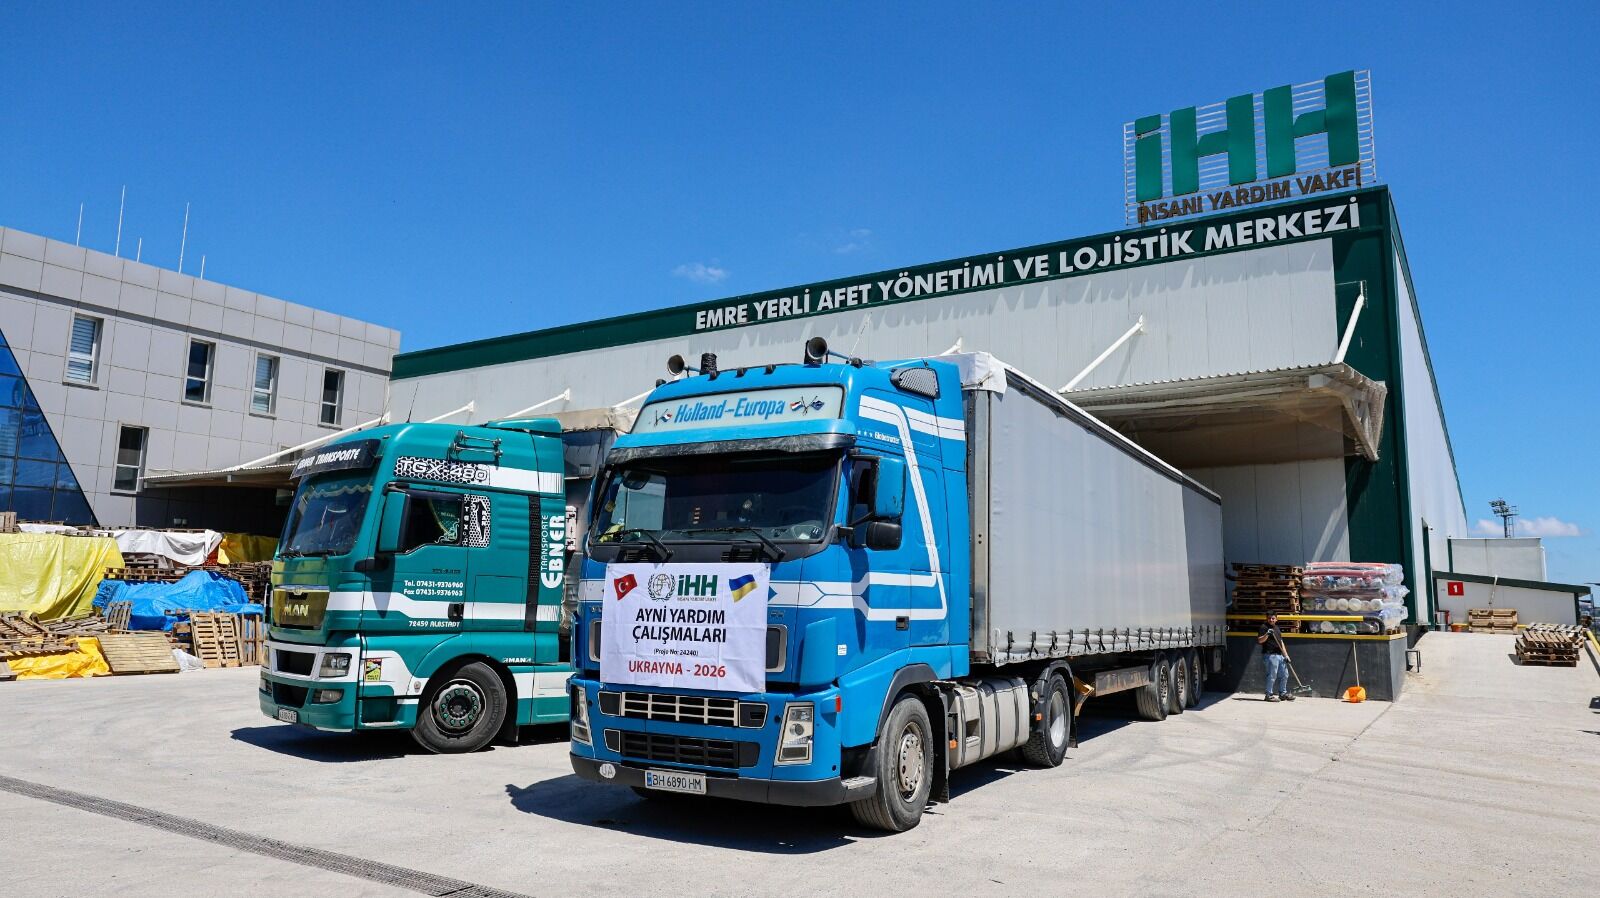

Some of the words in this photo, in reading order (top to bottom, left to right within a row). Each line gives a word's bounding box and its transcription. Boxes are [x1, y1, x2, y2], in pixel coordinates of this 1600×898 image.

[1207, 180, 1290, 210] YARDIM
[695, 303, 748, 330] EMRE
[753, 288, 810, 320] YERLİ
[817, 283, 872, 312] AFET
[877, 255, 1004, 301] YÖNETİMİ
[1013, 254, 1049, 281] VE
[1059, 228, 1195, 275] LOJİSTİK
[1204, 196, 1361, 251] MERKEZİ
[315, 448, 361, 465] TRANSPORTE
[540, 515, 565, 589] EBNER
[541, 514, 549, 571] TRANSPORTE
[1453, 584, 1458, 593] 1
[284, 604, 309, 617] MAN
[635, 606, 667, 623] AYNİ
[670, 608, 725, 625] YARDIM
[632, 625, 727, 644] ÇALIŞMALARI
[628, 660, 683, 675] UKRAYNA
[694, 664, 726, 678] 2026
[652, 774, 665, 786] BH
[667, 776, 687, 789] 6890
[688, 778, 702, 791] HM
